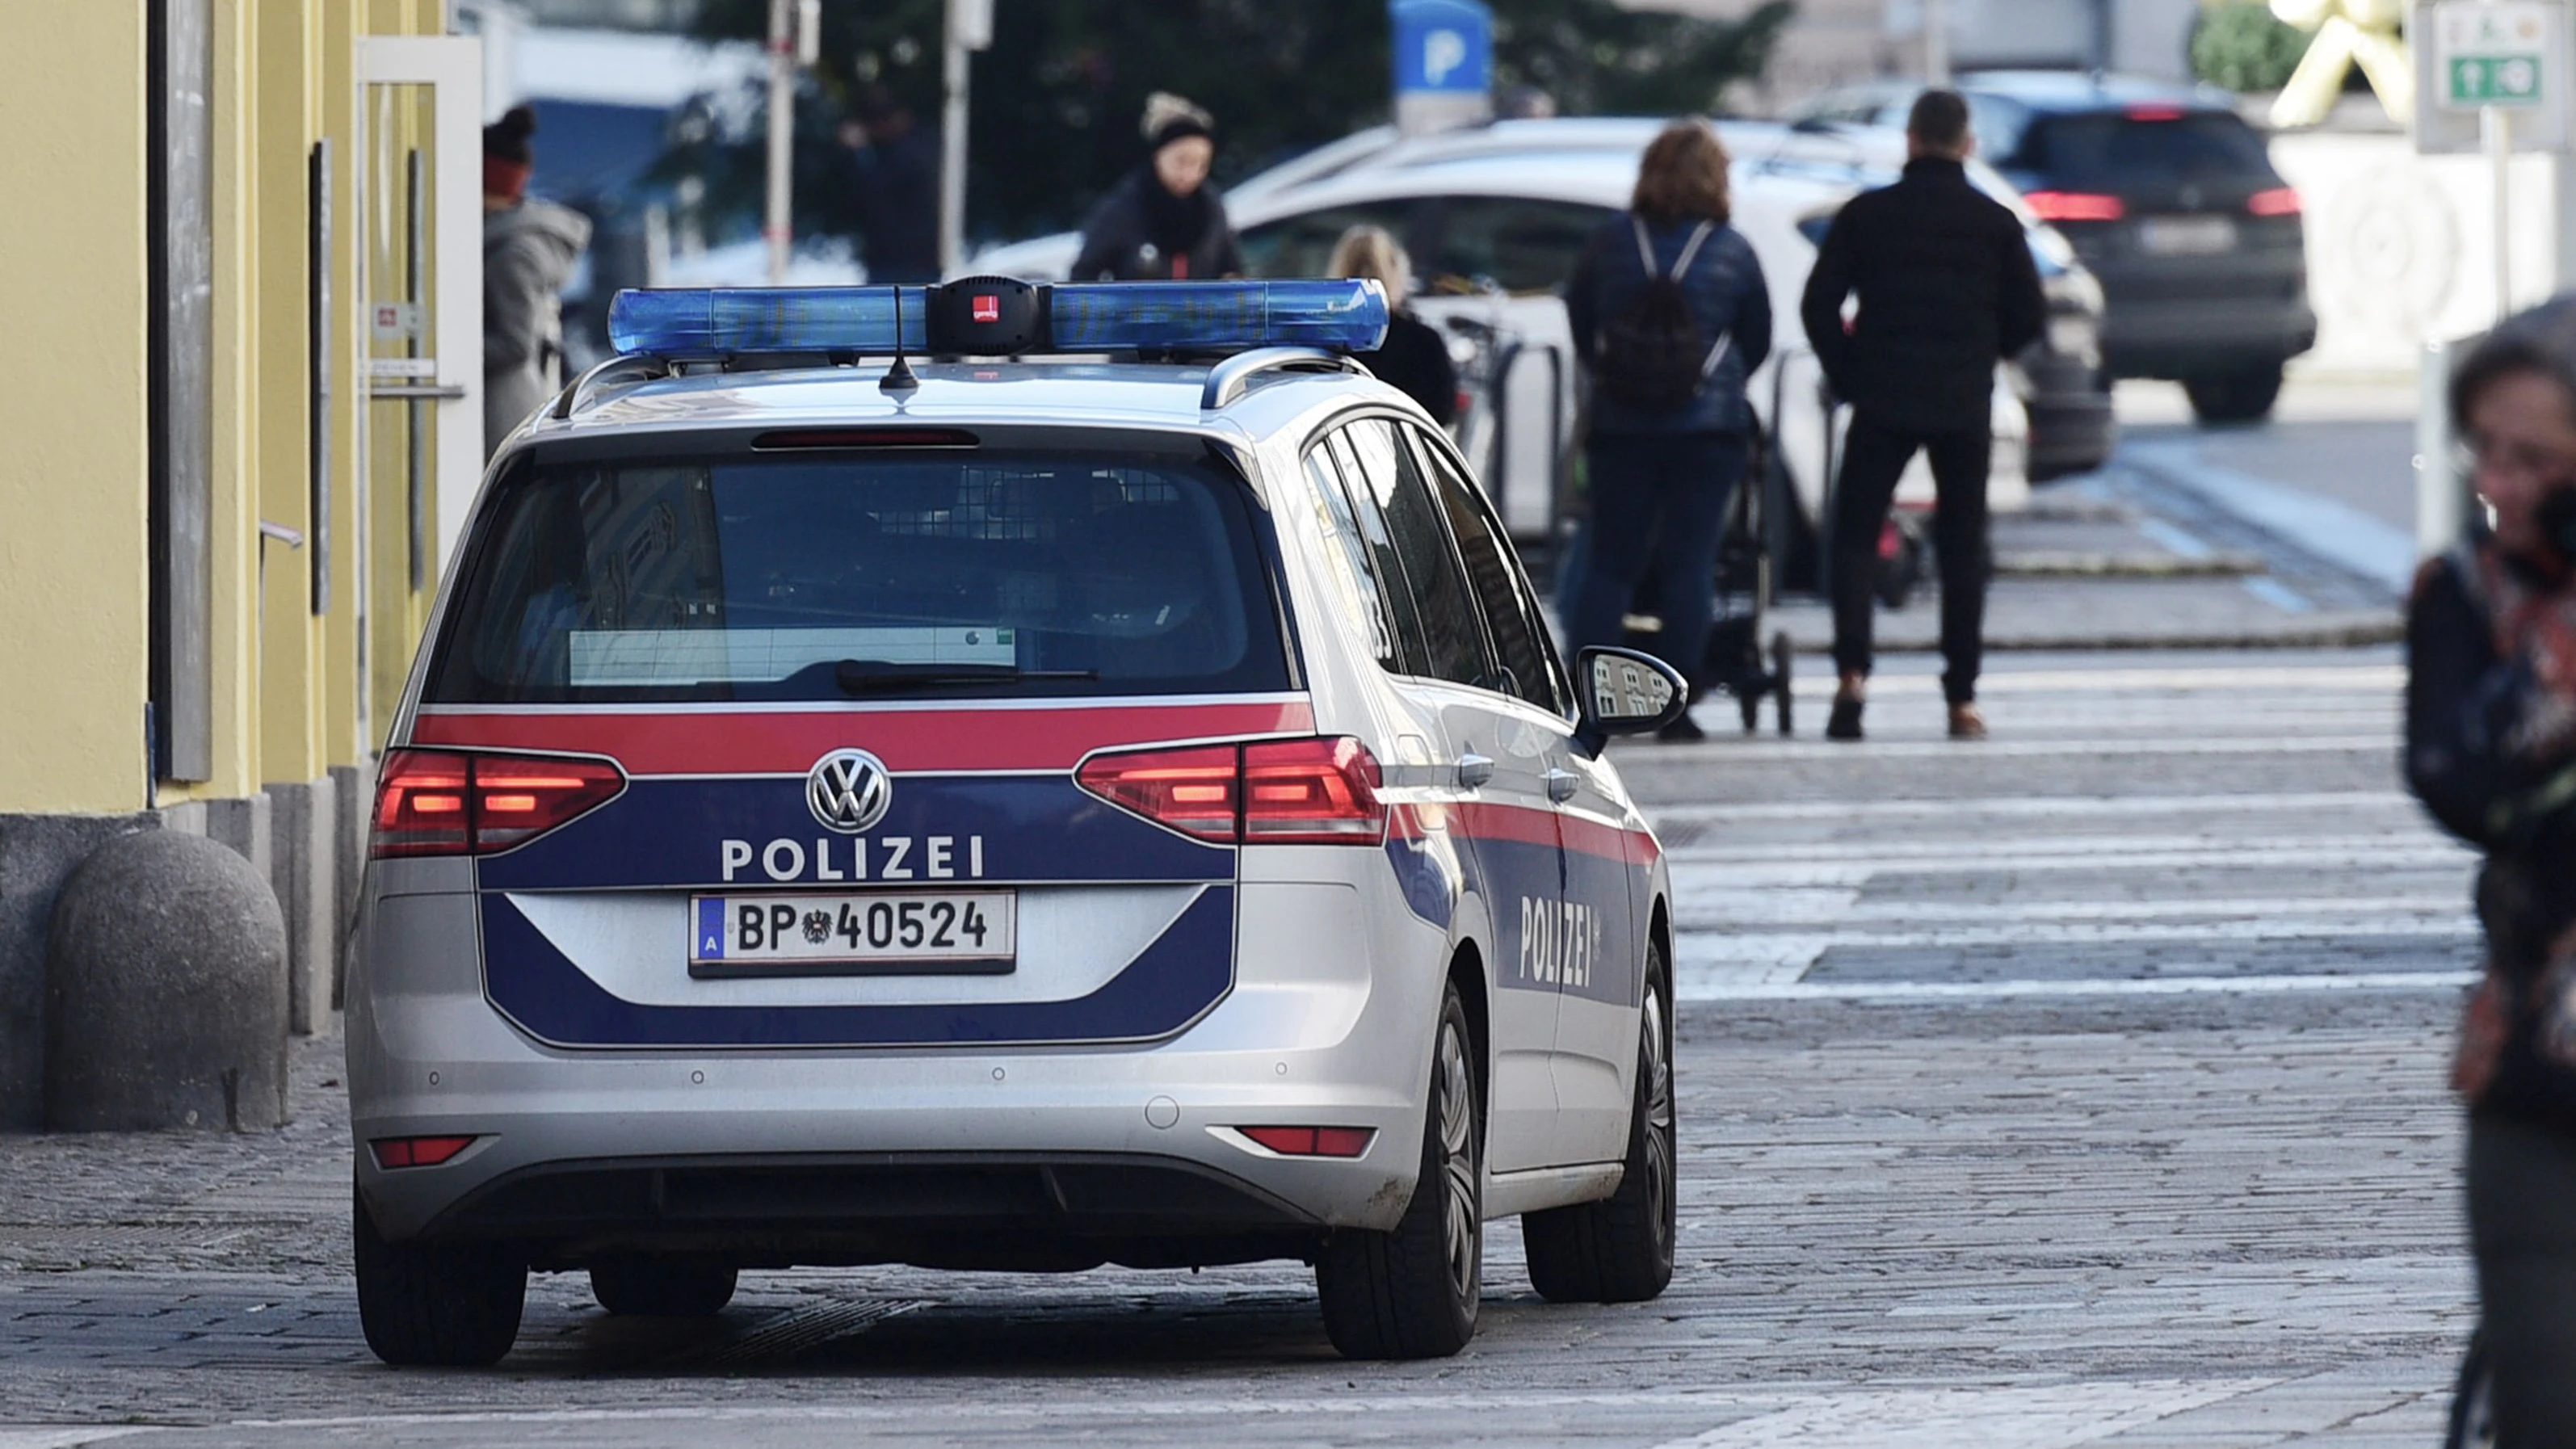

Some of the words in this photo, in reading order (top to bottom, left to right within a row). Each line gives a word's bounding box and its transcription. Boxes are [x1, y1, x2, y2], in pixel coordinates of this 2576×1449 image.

[1423, 29, 1466, 86] P
[721, 835, 983, 882] POLIZEI
[704, 935, 718, 951] A
[738, 904, 796, 951] BP
[836, 901, 987, 949] 40524
[1519, 896, 1591, 988] POLIZEI
